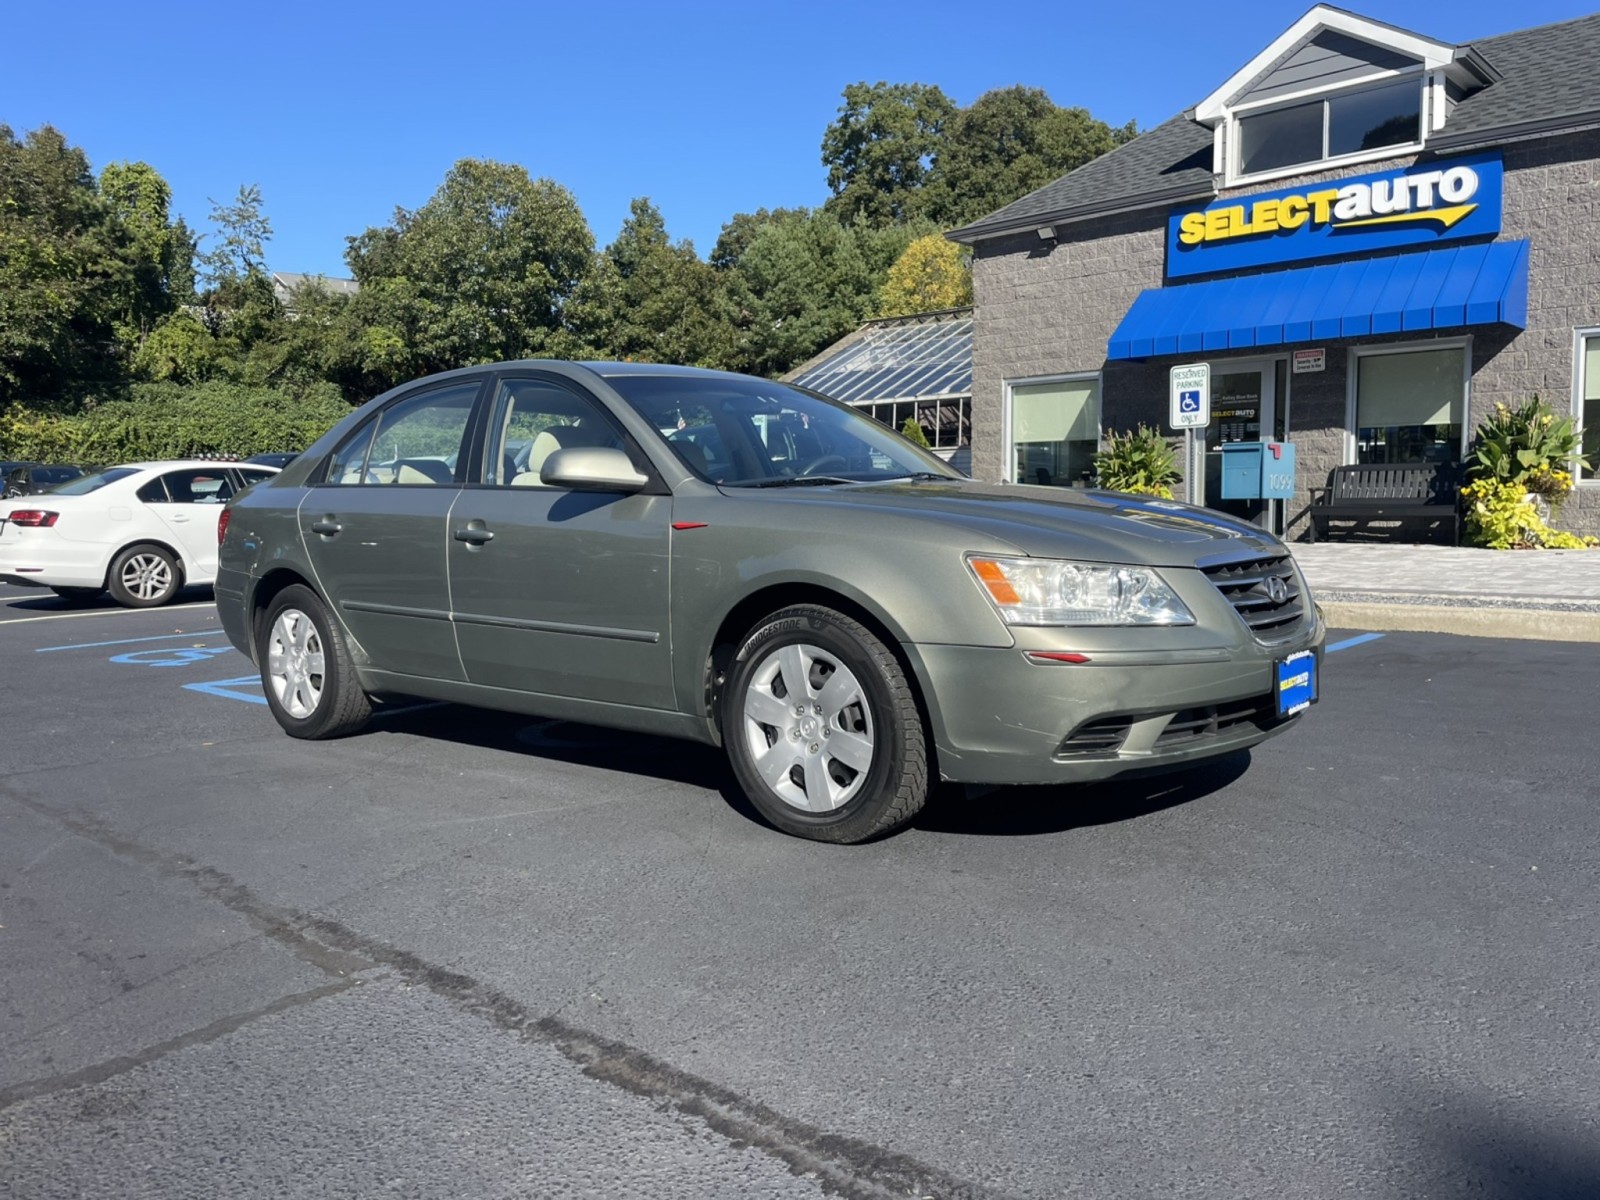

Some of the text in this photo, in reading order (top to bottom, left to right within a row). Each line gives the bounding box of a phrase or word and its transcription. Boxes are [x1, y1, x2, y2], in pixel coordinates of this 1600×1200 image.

[1174, 369, 1206, 380] RESERVED
[1176, 380, 1203, 389] PARKING
[1181, 414, 1199, 423] ONLY
[1269, 473, 1293, 490] 1099
[744, 619, 801, 653] BRIDGESTONE
